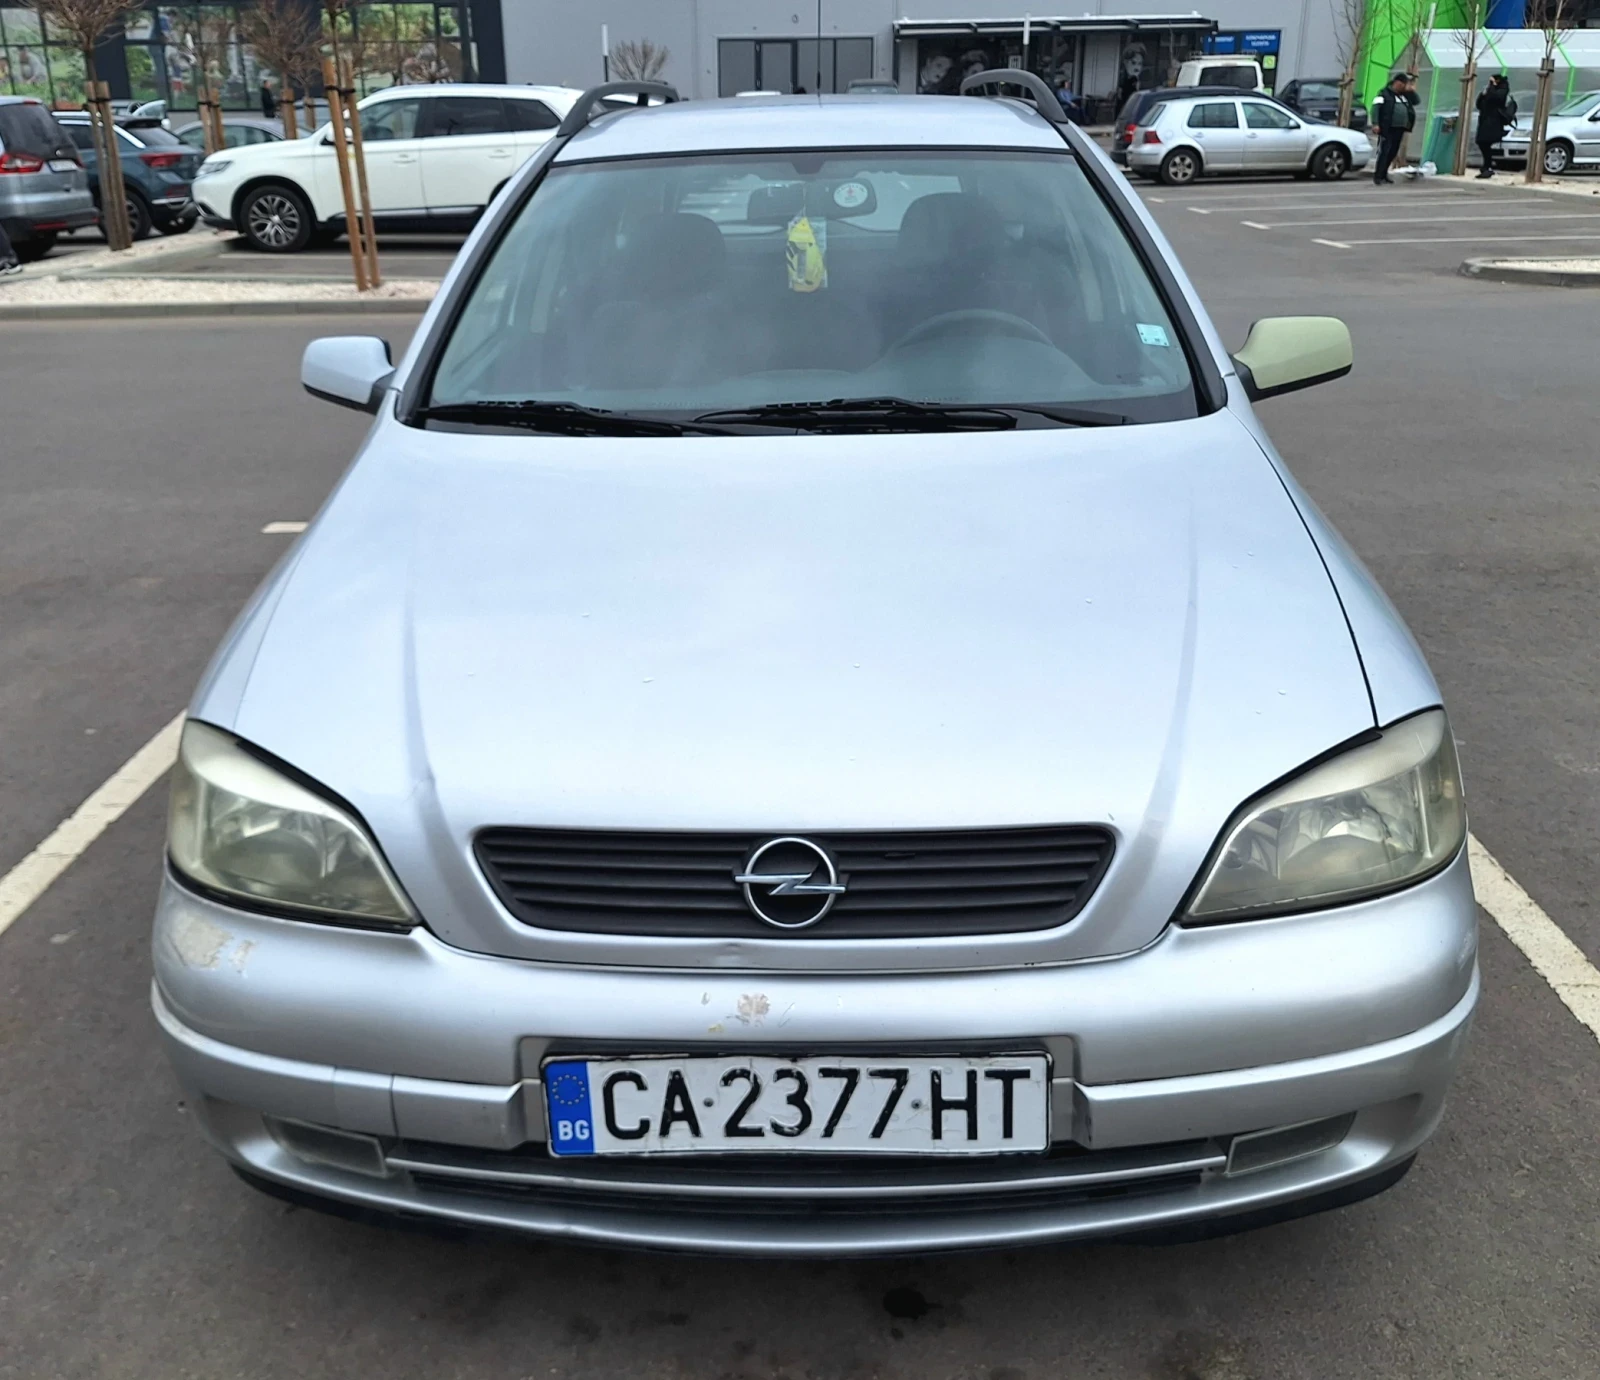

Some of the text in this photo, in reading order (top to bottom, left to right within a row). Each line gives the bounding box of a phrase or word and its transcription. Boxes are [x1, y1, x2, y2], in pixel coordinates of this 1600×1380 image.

[602, 1067, 1031, 1140] CA 2377 HT
[557, 1119, 591, 1141] BG
